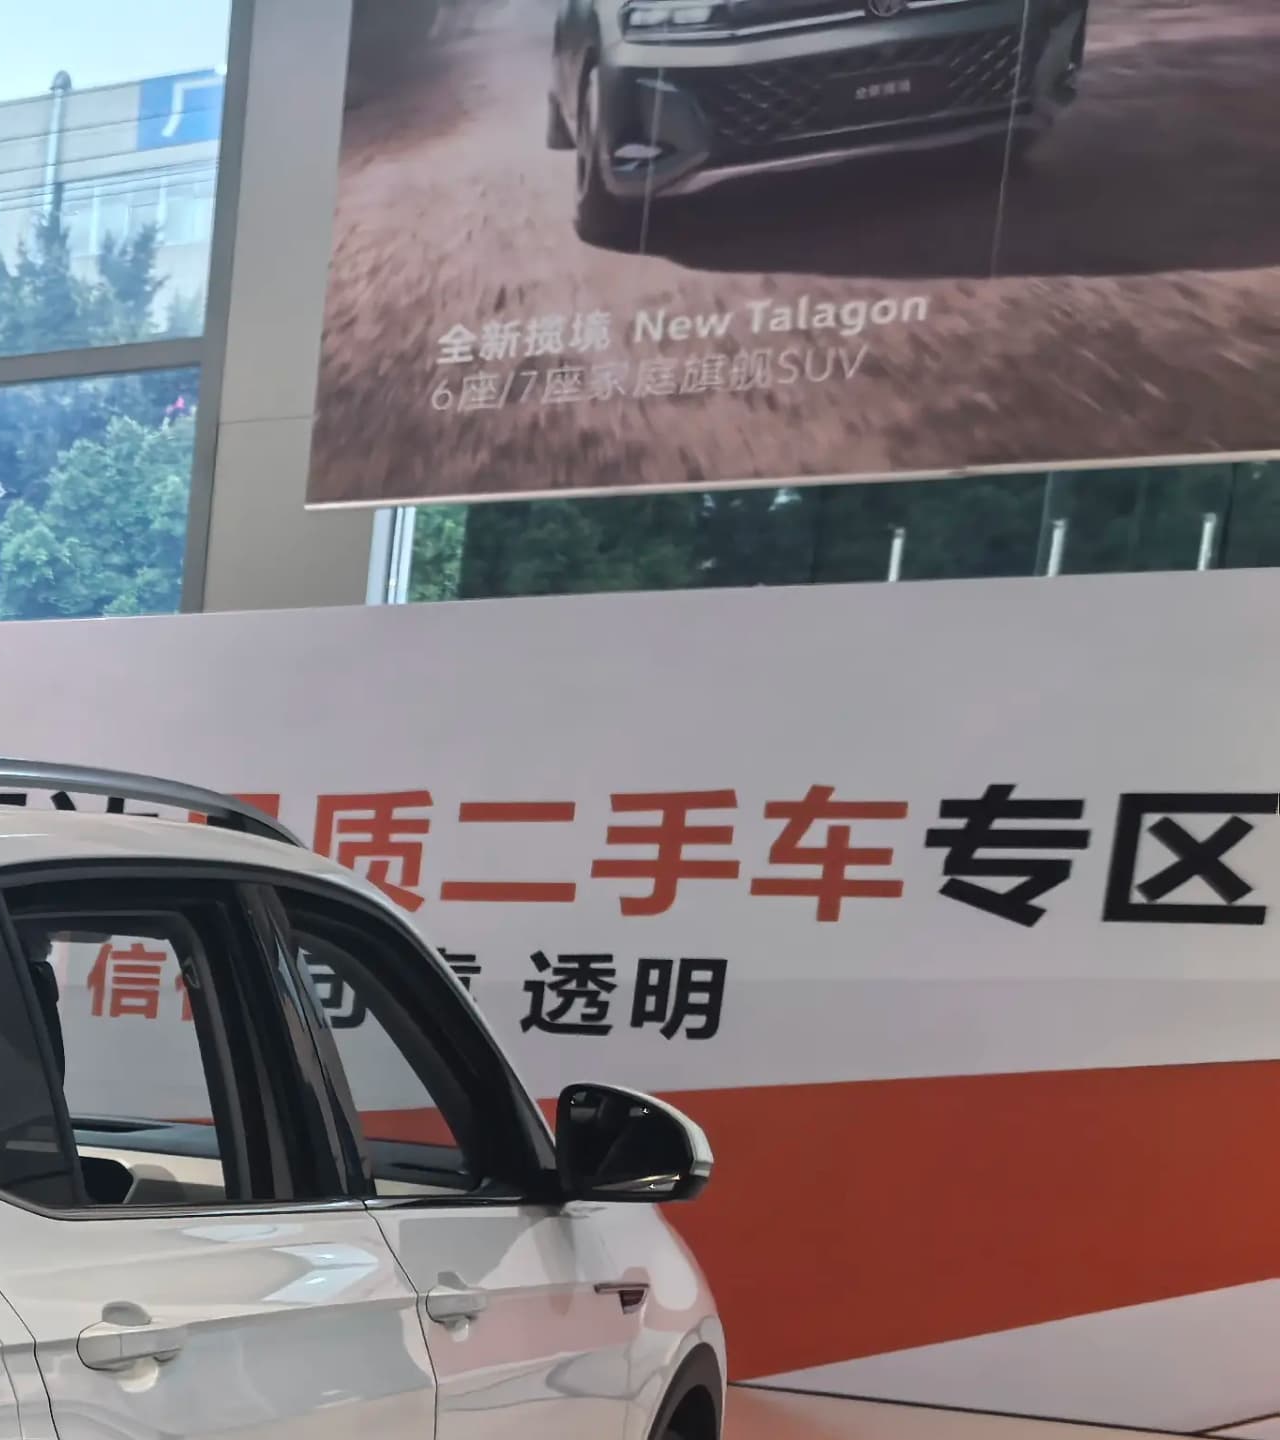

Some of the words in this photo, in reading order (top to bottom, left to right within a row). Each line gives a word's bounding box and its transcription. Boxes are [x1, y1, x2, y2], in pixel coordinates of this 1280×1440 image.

[436, 309, 612, 365] 全新揽境
[634, 308, 735, 343] New
[746, 294, 929, 337] Talagon
[431, 344, 869, 413] 6座/7座家庭旗舰SUV
[521, 949, 728, 1040] 透明
